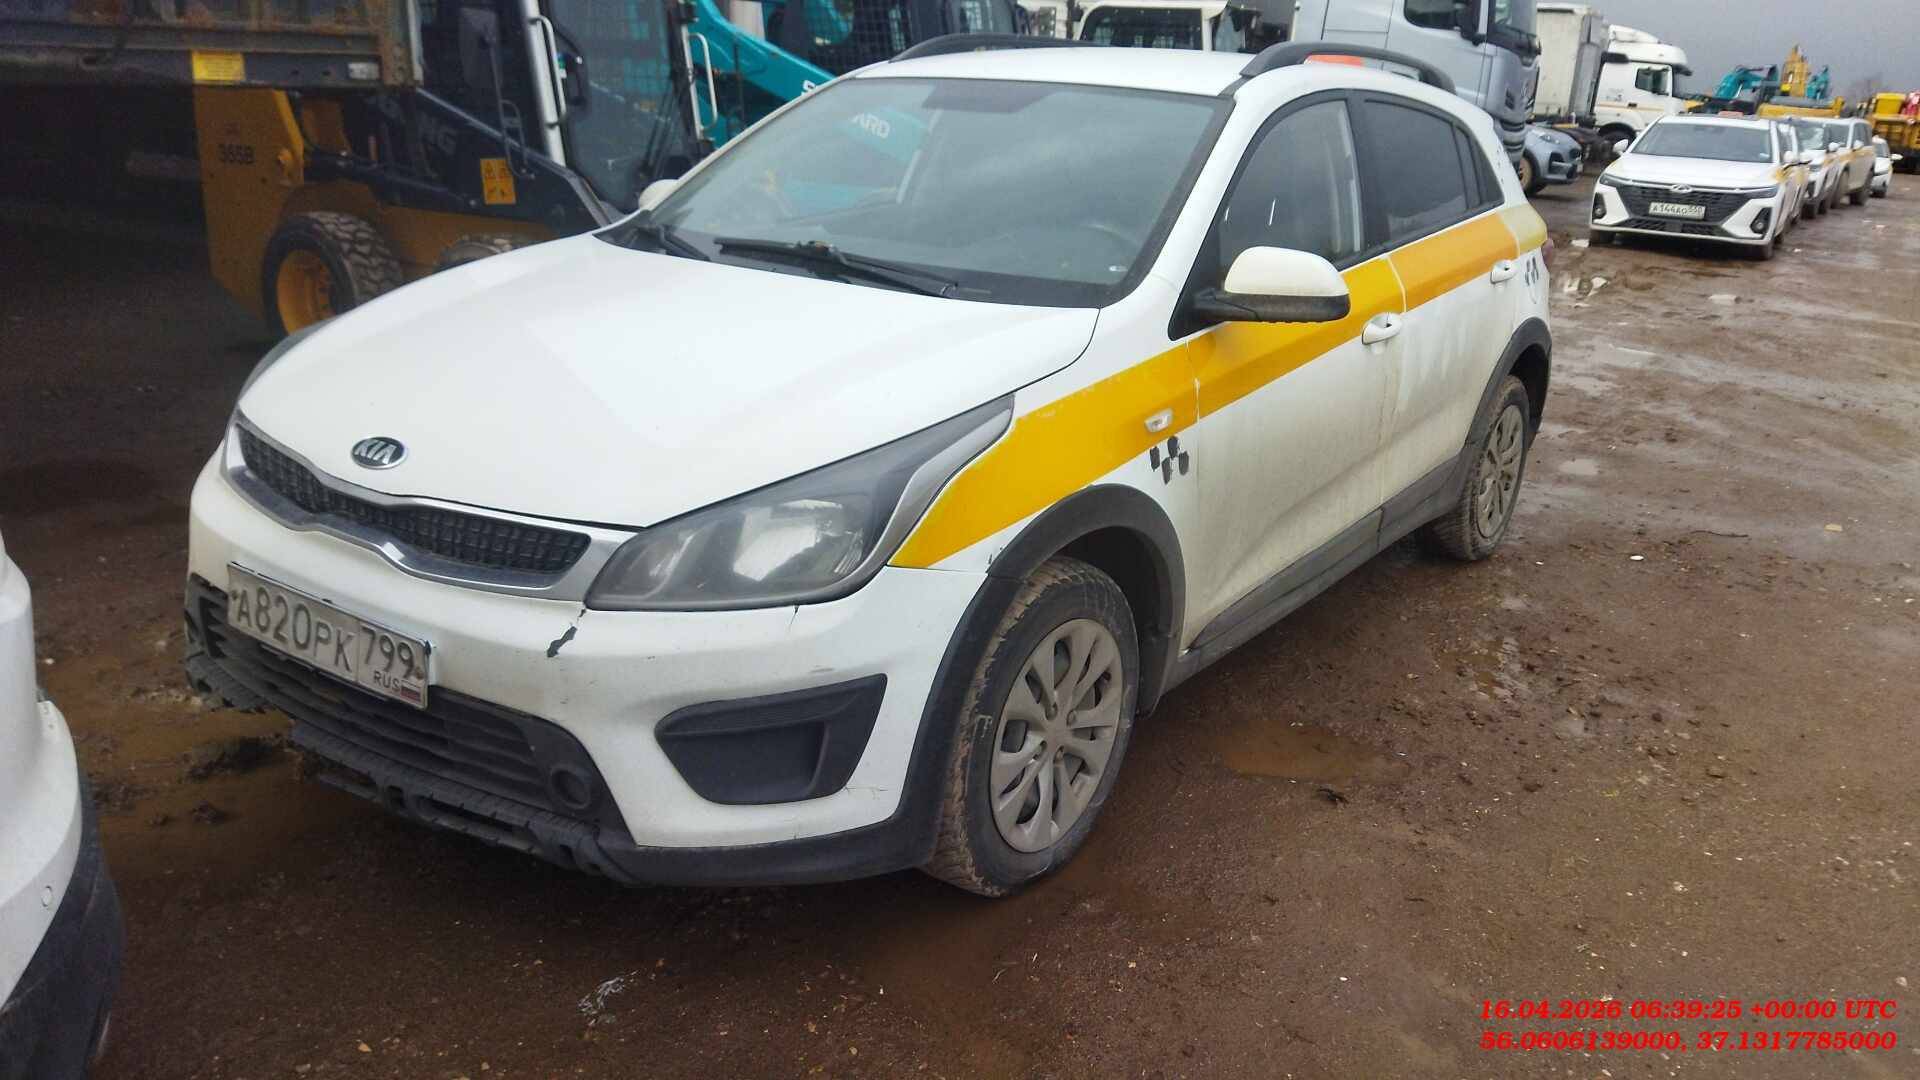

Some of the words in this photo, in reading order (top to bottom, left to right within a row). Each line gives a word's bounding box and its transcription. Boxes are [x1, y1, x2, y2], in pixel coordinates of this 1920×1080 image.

[354, 440, 397, 465] KIA
[362, 626, 415, 679] 799
[373, 670, 401, 692] RUS
